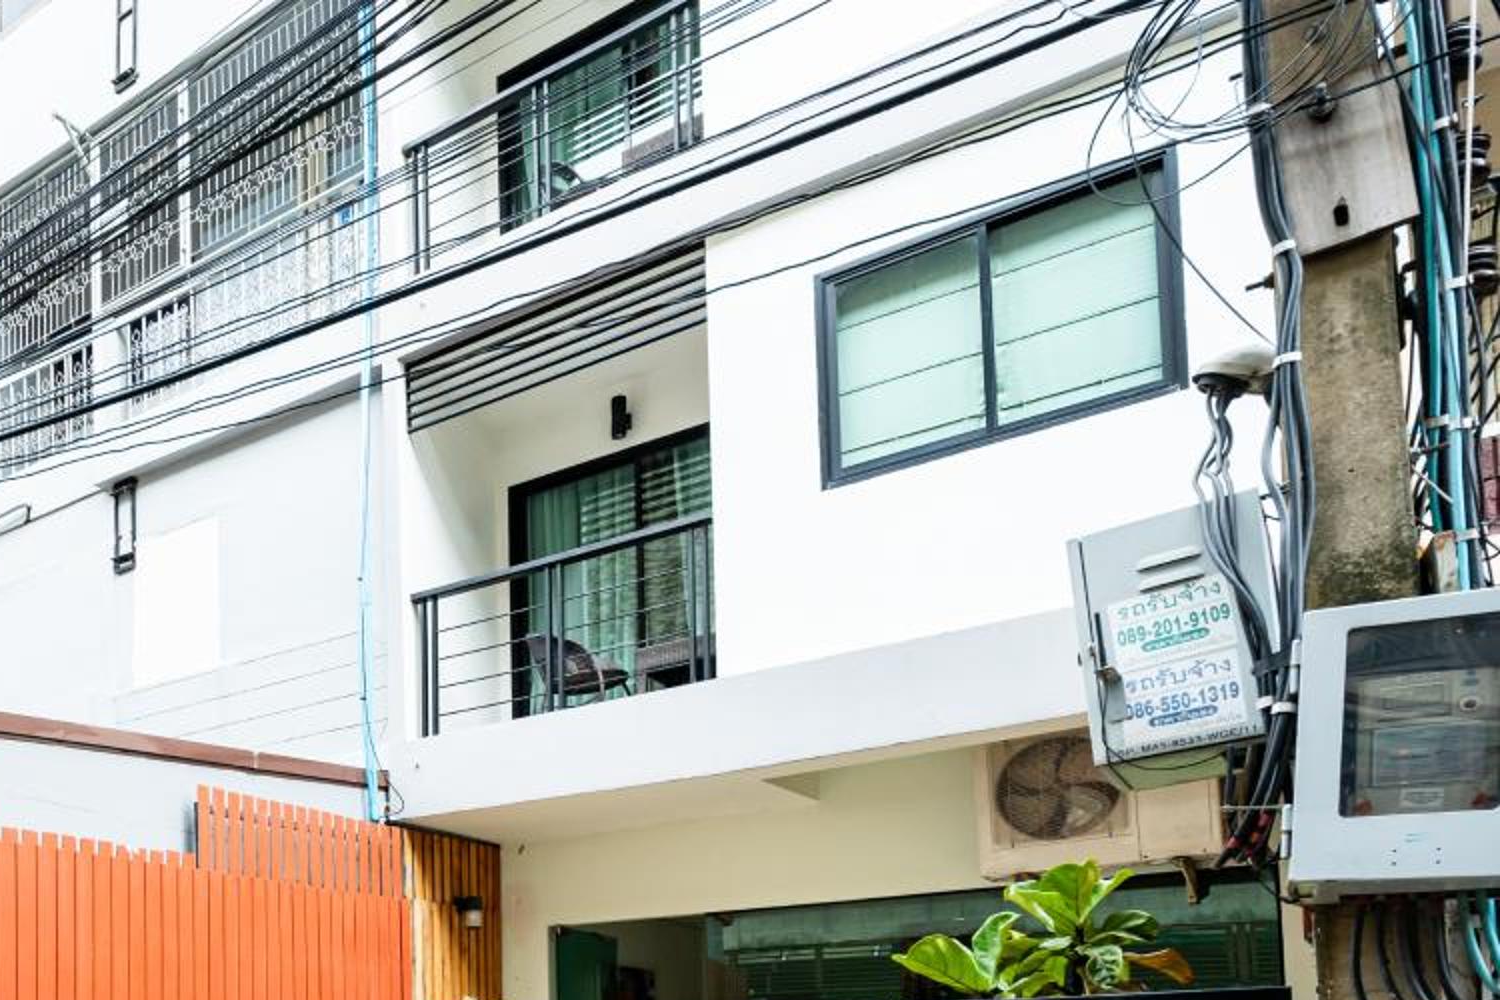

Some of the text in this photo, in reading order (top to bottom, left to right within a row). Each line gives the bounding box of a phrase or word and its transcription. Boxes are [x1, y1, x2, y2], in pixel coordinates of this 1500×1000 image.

[1117, 581, 1221, 618] รถรับจ้าง
[1117, 603, 1231, 646] 089-201-9109
[1126, 658, 1232, 693] รถรับจ้าง
[1126, 681, 1240, 719] 086-550-1319
